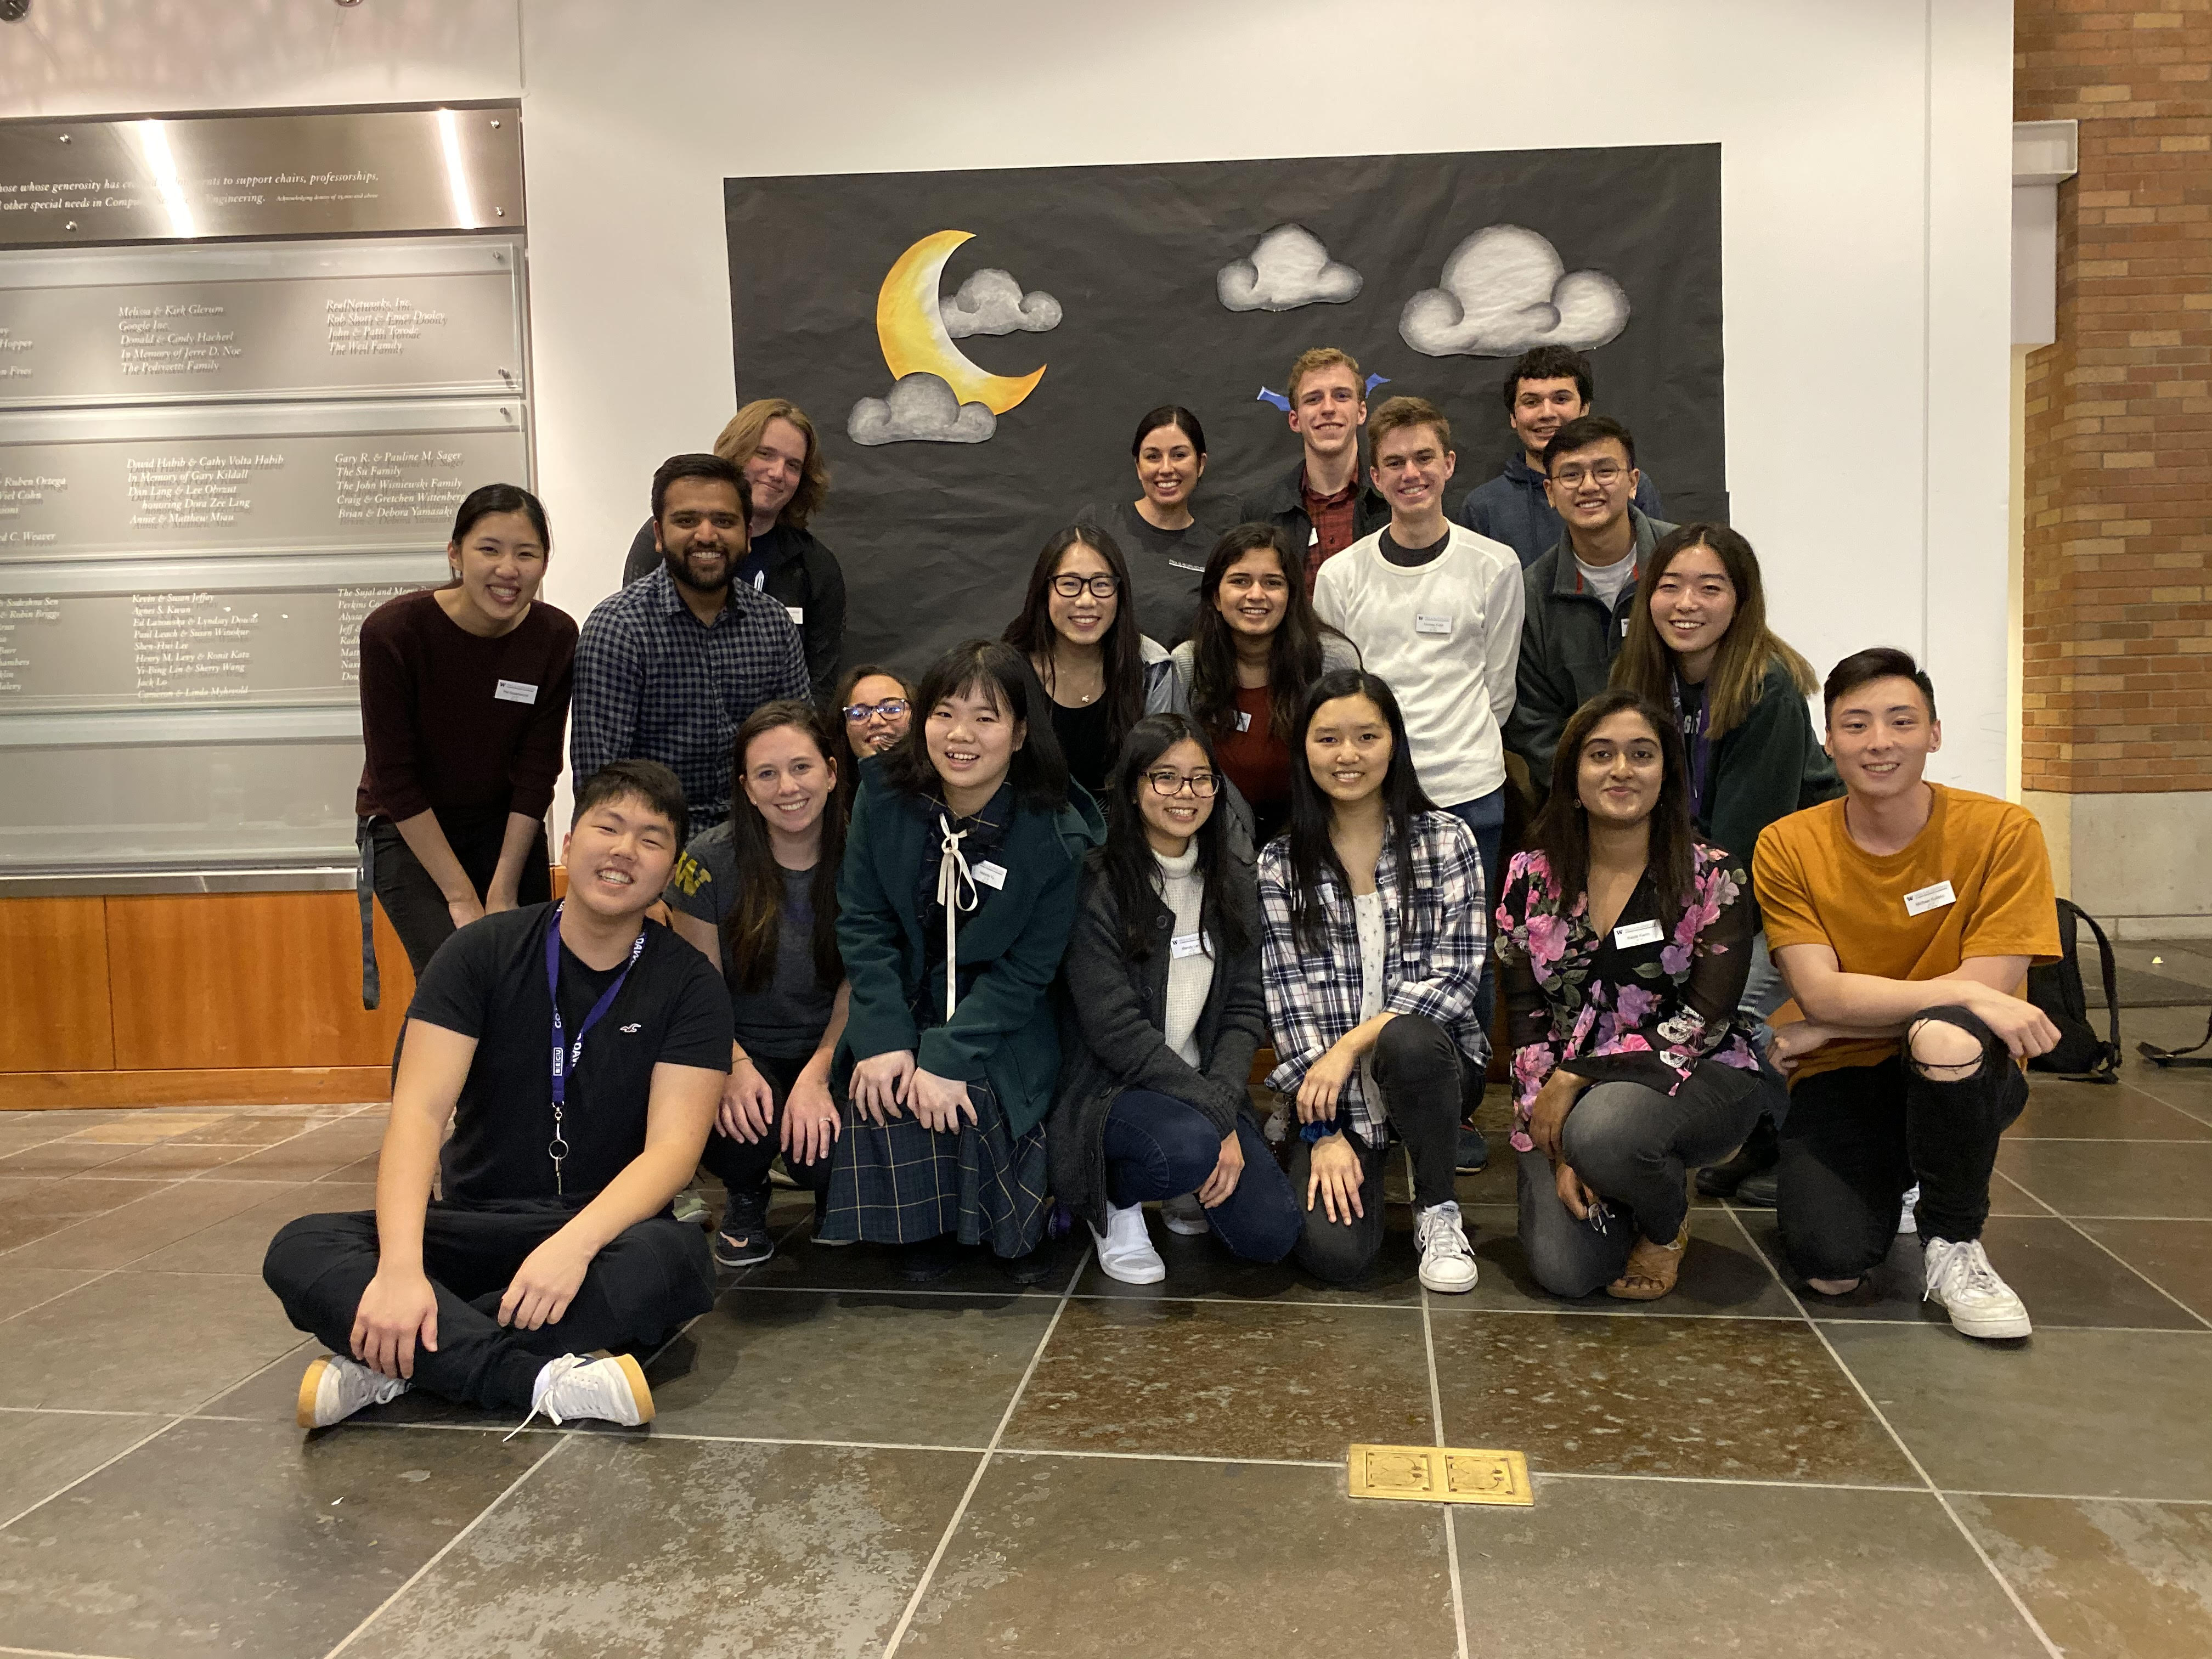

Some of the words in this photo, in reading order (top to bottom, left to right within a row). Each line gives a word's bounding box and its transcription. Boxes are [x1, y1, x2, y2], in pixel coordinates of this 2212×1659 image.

[20, 182, 49, 192] whose
[52, 180, 101, 194] generosity
[104, 179, 119, 189] has
[236, 176, 272, 187] support
[275, 173, 306, 184] chairs,
[309, 171, 379, 185] professorships,
[4, 200, 29, 210] other
[30, 199, 62, 212] special
[65, 197, 90, 208] needs
[93, 198, 102, 207] in
[396, 298, 412, 307] Inc.
[119, 307, 150, 317] Melissa
[154, 307, 162, 315] &
[327, 314, 345, 323] Rob
[348, 313, 372, 322] Short
[386, 312, 411, 321] Emer
[414, 311, 445, 320] Dooley
[119, 321, 150, 333] Google
[329, 328, 349, 338] John
[364, 326, 385, 335] Patti
[388, 325, 419, 335] Torode
[121, 335, 153, 344] Donald
[168, 333, 194, 345] Cindy
[329, 342, 345, 351] The
[349, 341, 369, 350] Weil
[371, 340, 402, 351] Family
[121, 349, 131, 358] In
[134, 348, 171, 359] Memory
[173, 347, 183, 362] of
[185, 348, 206, 359] Jerre
[209, 346, 219, 356] D.
[223, 346, 241, 356] Noe
[122, 363, 139, 372] The
[188, 360, 219, 370] Family
[127, 458, 154, 469] David
[157, 458, 185, 467] Habib
[188, 458, 197, 466] &
[199, 456, 226, 467] Cathy
[229, 455, 251, 465] Volta
[256, 454, 284, 465] Habib
[335, 453, 357, 464] Gary
[360, 453, 370, 462] R.
[374, 453, 382, 462] &
[385, 452, 419, 461] Pauline
[422, 451, 434, 460] M.
[437, 450, 462, 462] Sager
[128, 473, 137, 482] In
[141, 472, 177, 482] Memory
[180, 471, 189, 482] of
[192, 471, 213, 481] Gary
[217, 469, 248, 479] Kildall
[336, 467, 353, 476] The
[356, 466, 367, 476] Su
[371, 466, 402, 476] Family
[336, 481, 353, 490] The
[356, 480, 376, 492] John
[380, 478, 428, 489] Wisniewski
[431, 478, 462, 489] Family
[127, 486, 147, 496] Dan
[150, 485, 172, 498] Ling
[187, 486, 203, 494] Lee
[142, 500, 182, 511] honoring
[185, 498, 207, 508] Dora
[210, 498, 226, 507] Zee
[229, 497, 251, 509] Ling
[337, 495, 361, 506] Craig
[375, 494, 414, 503] Gretchen
[417, 492, 467, 503] Wittenberg
[338, 509, 363, 518] Brian
[377, 507, 409, 517] Debora
[412, 506, 453, 516] Yamasaki
[129, 515, 156, 524] Annie
[158, 515, 167, 523] &
[170, 514, 208, 523] Matthew
[210, 513, 234, 521] Miau
[9, 532, 20, 540] C.
[23, 531, 56, 540] Weaver
[132, 594, 155, 603] Kevin
[167, 593, 190, 602] Susan
[337, 589, 353, 597] The
[354, 588, 375, 599] Sujal
[377, 587, 392, 595] and
[132, 606, 155, 616] Agnes
[157, 606, 164, 614] S.
[338, 600, 366, 610] Perkins
[133, 618, 144, 627] Ed
[338, 613, 362, 622] Alyssa
[134, 630, 152, 639] Paul
[154, 629, 177, 638] Leach
[180, 629, 188, 637] &
[189, 628, 212, 637] Susan
[339, 624, 354, 635] Jeff
[135, 654, 160, 664] Henry
[162, 653, 173, 662] M.
[195, 664, 220, 674] Sherry
[223, 663, 245, 673] Wang
[137, 678, 154, 688] Jack
